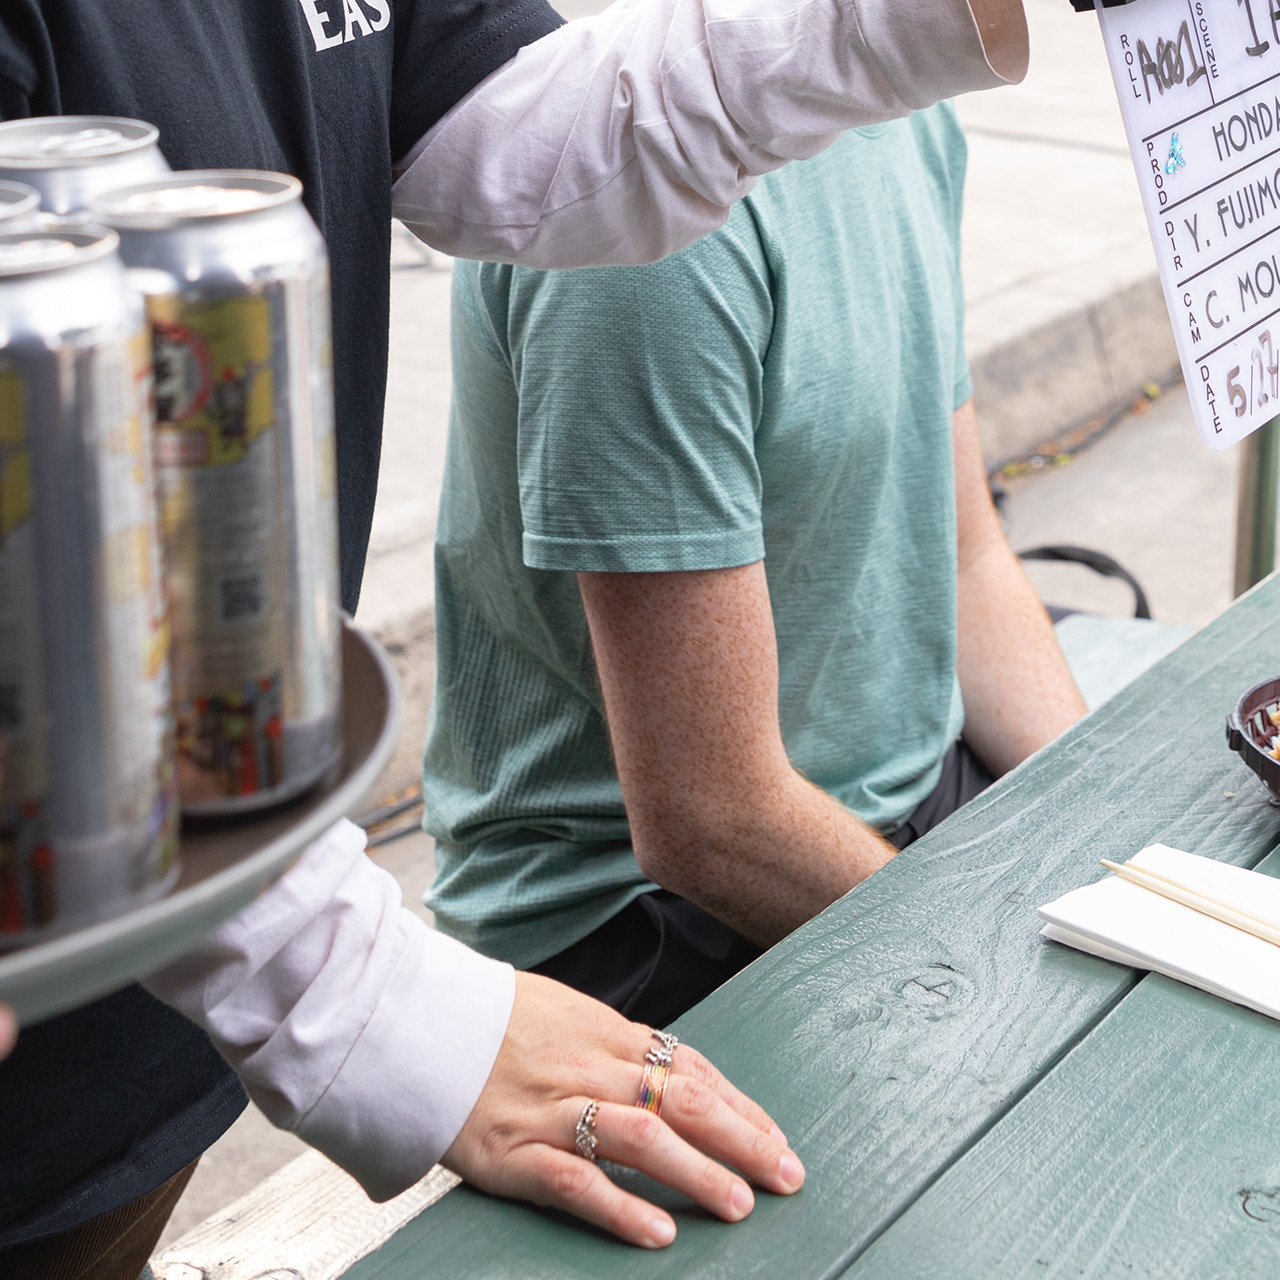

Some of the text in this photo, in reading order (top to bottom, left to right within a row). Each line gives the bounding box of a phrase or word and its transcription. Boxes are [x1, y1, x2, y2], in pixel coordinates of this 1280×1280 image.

[1120, 34, 1141, 98] ROLL
[1195, 2, 1219, 79] SCENE
[1146, 142, 1168, 206] PROD
[1165, 221, 1183, 270] DIR
[1184, 213, 1211, 253] Y.
[1183, 293, 1201, 343] CAM
[1205, 289, 1230, 328] C.
[1200, 365, 1222, 434] DATE
